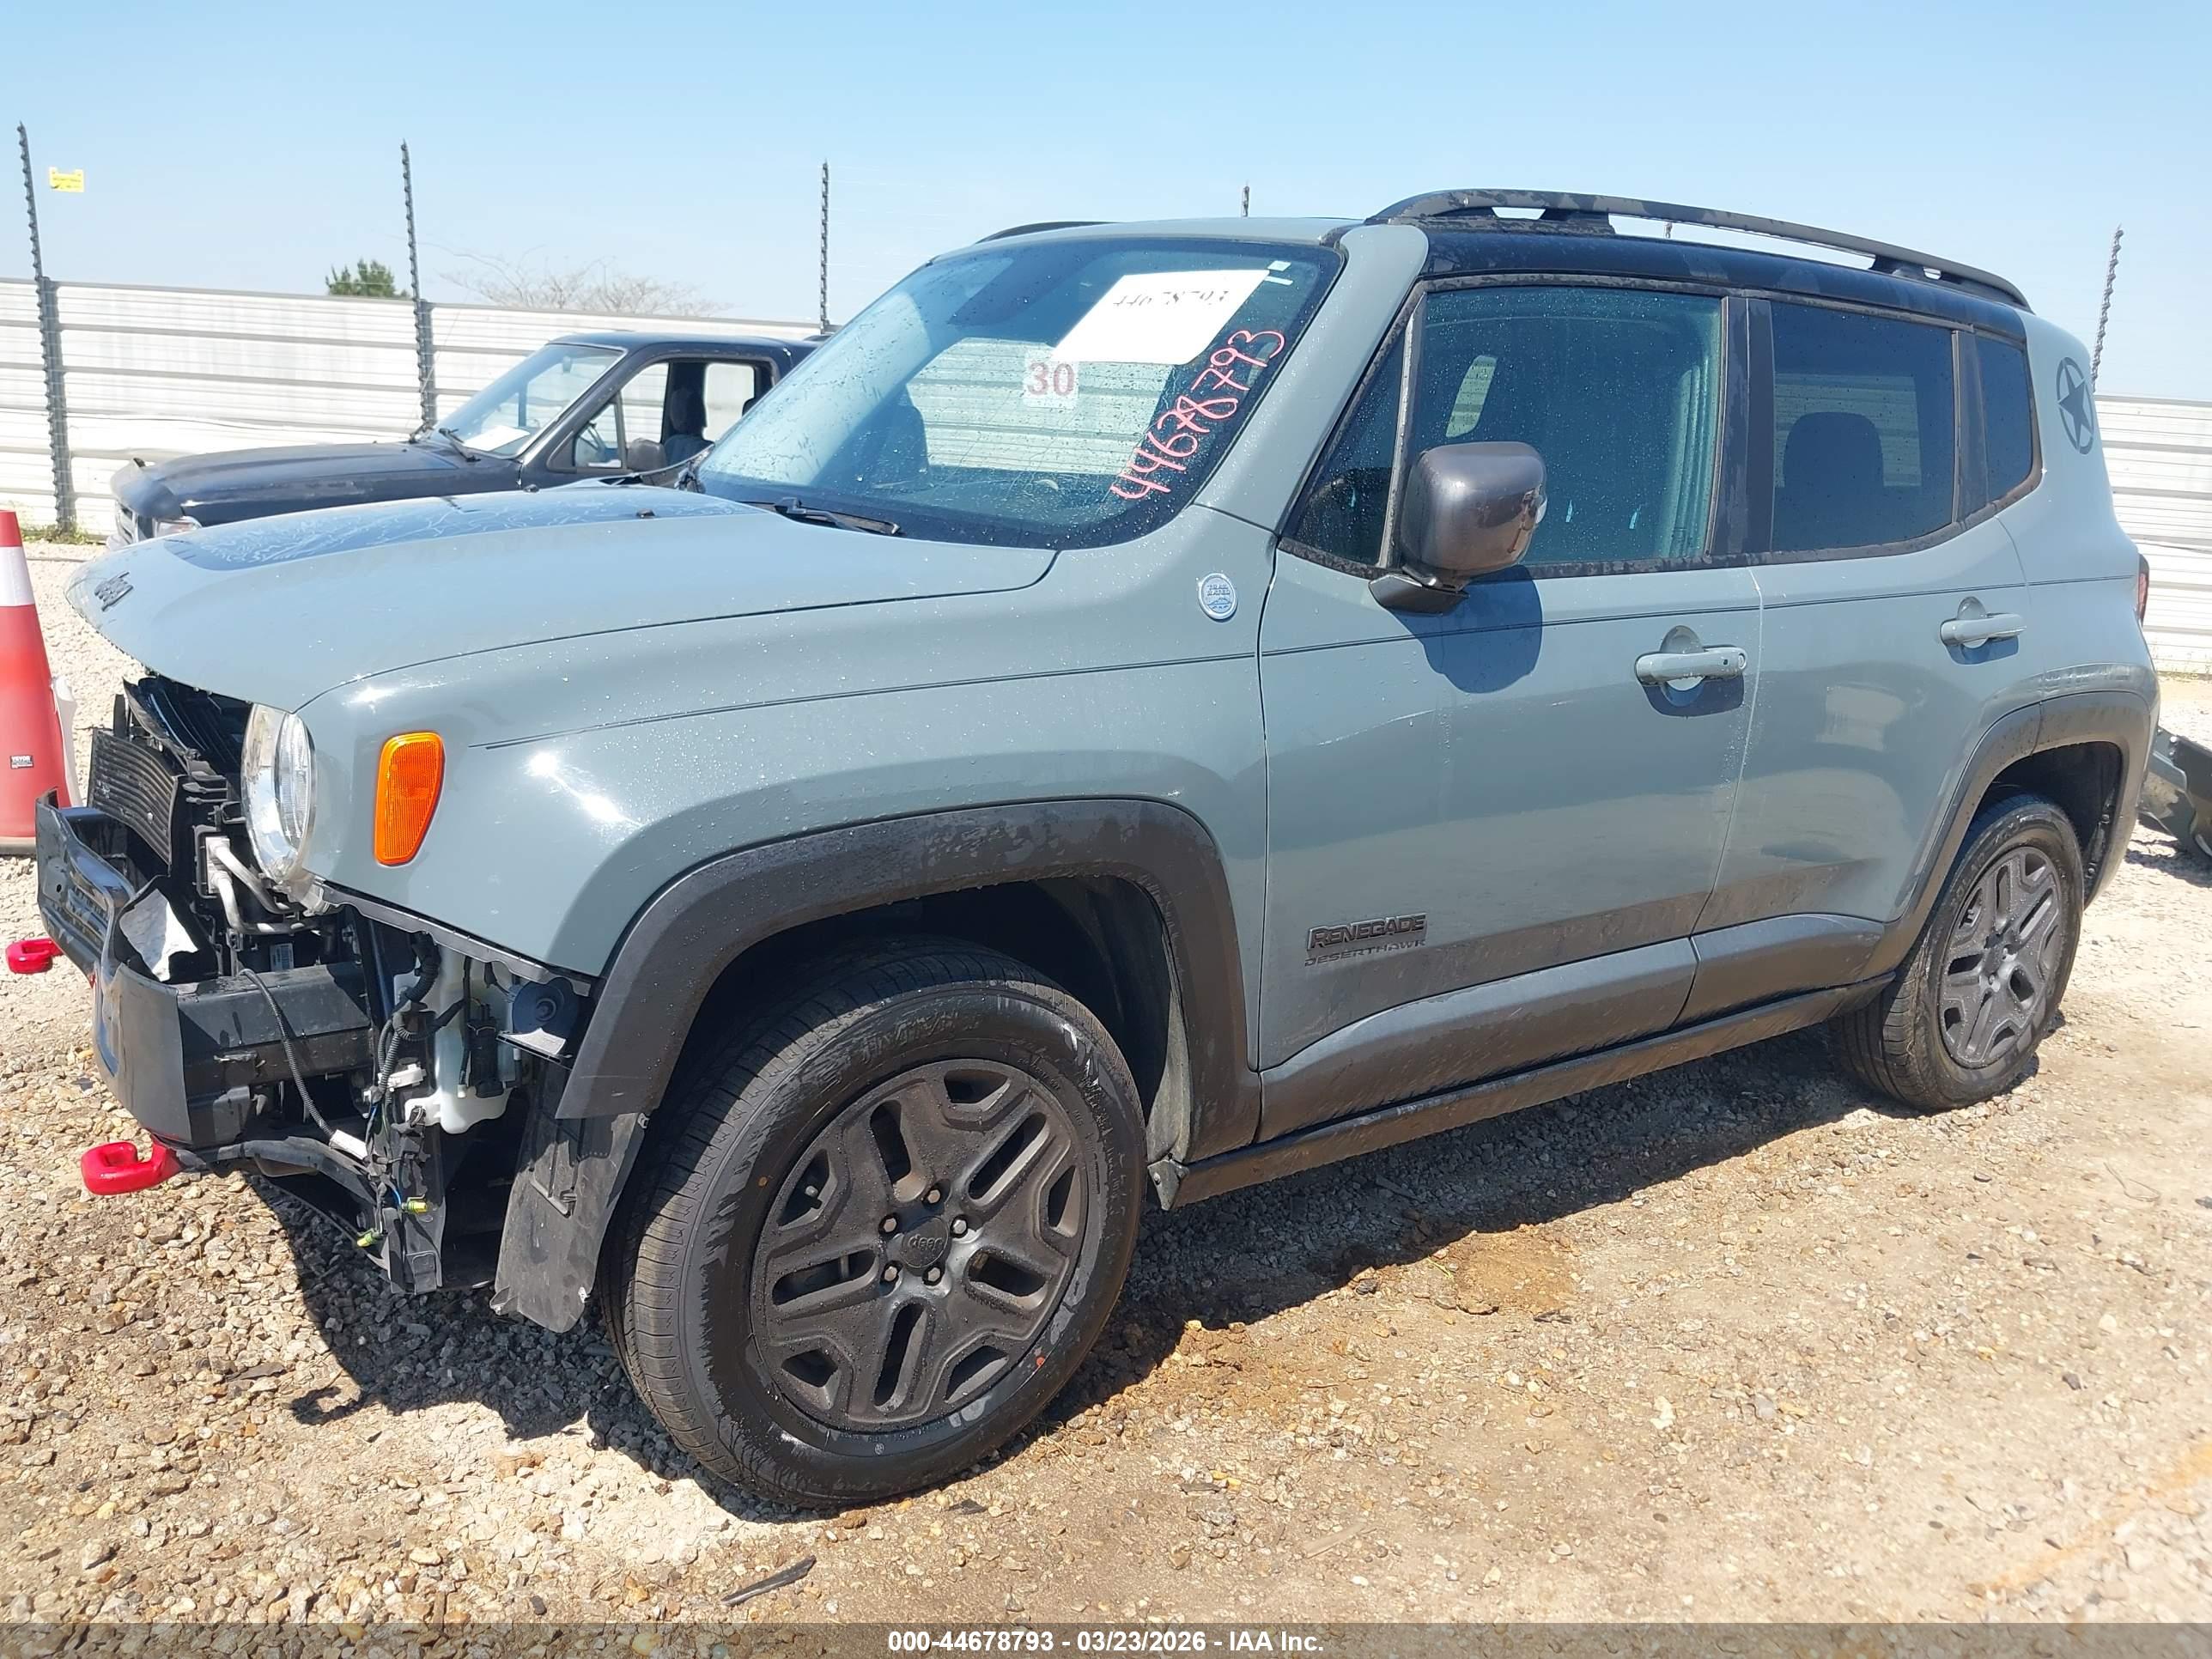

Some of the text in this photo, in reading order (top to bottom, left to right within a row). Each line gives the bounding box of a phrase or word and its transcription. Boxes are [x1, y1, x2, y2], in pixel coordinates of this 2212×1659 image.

[1026, 362, 1075, 397] 30
[1109, 330, 1285, 501] 44678793
[1306, 913, 1427, 951] RENEGADE
